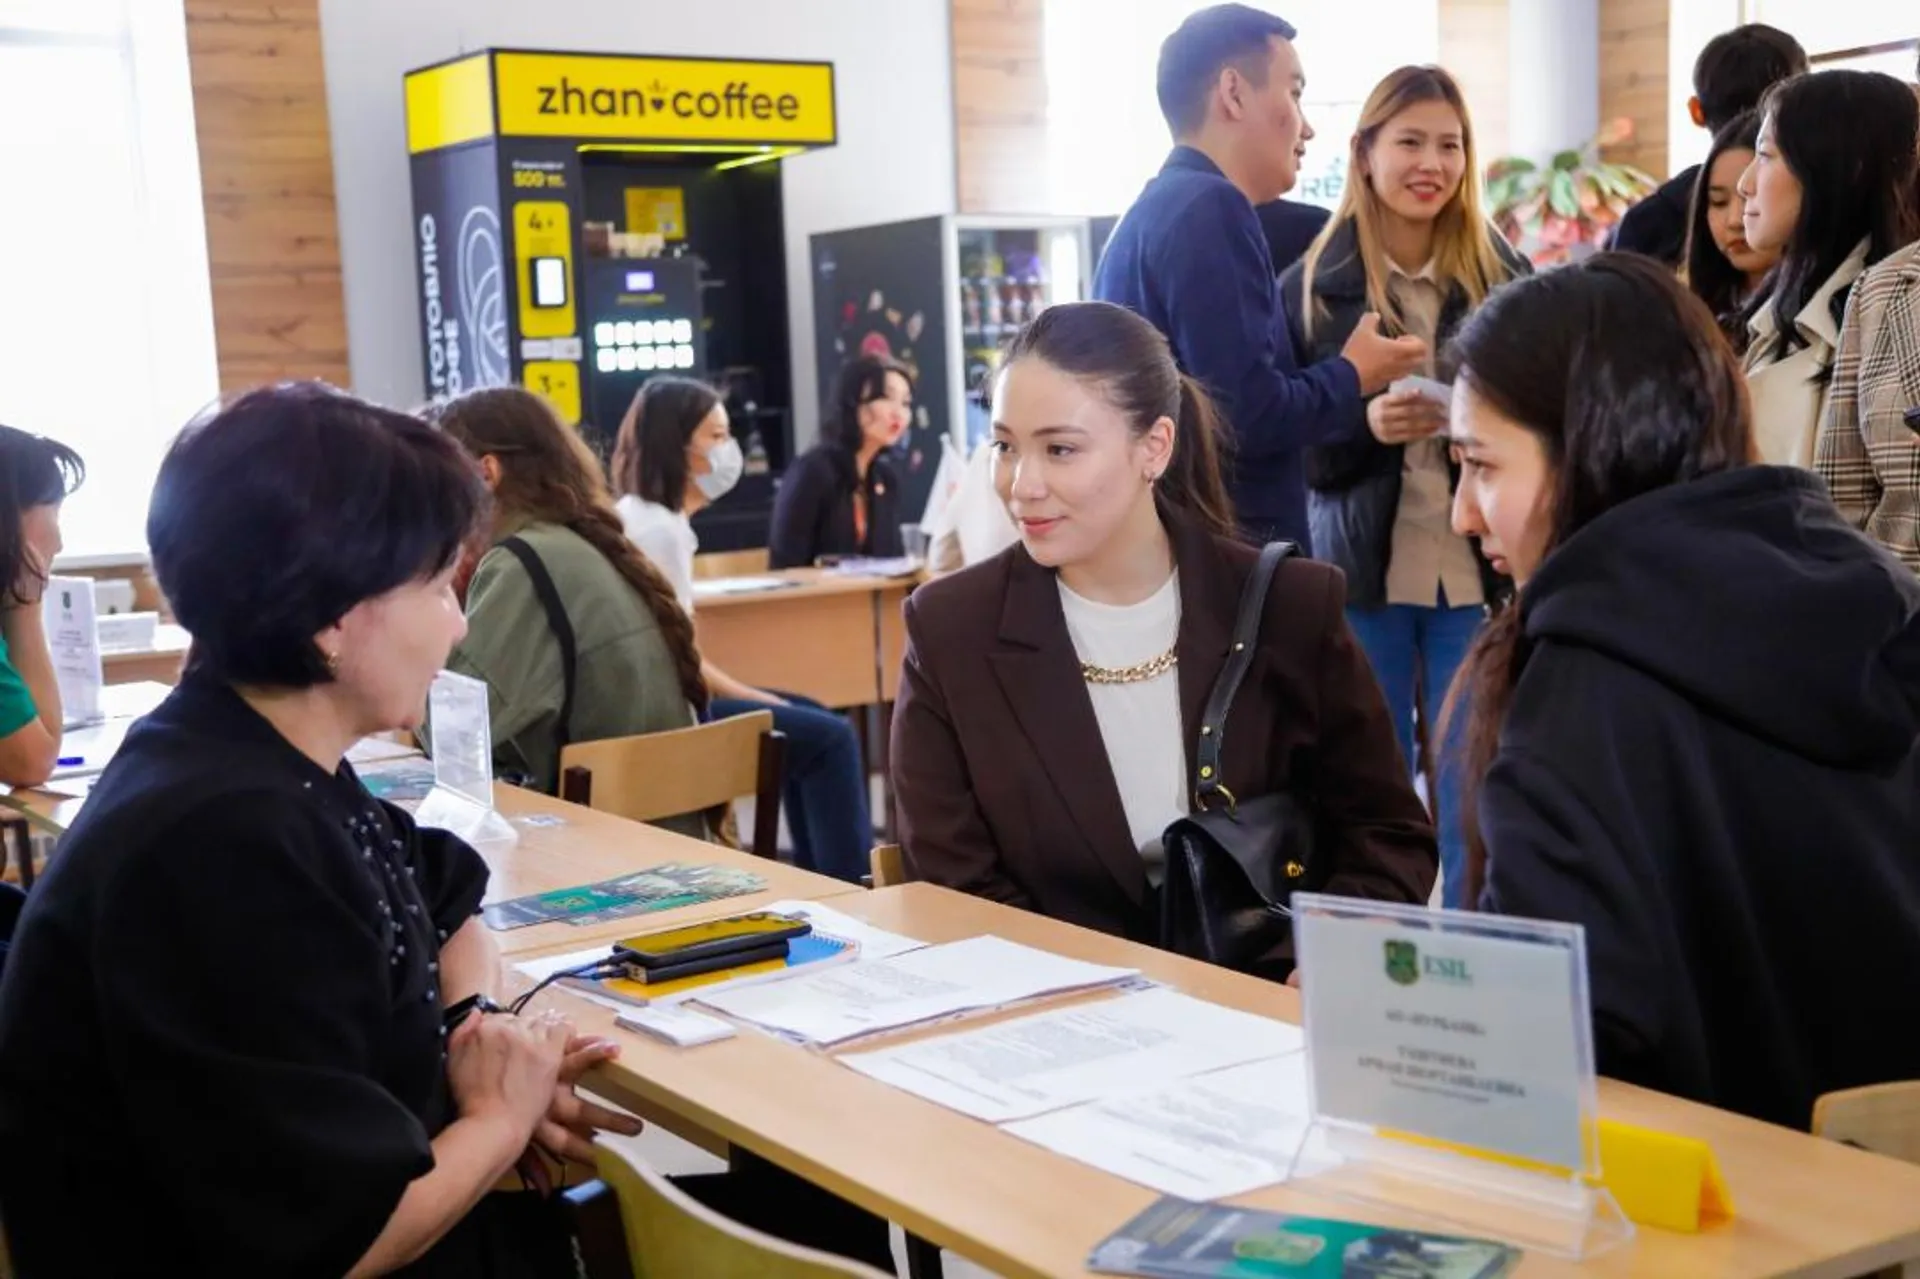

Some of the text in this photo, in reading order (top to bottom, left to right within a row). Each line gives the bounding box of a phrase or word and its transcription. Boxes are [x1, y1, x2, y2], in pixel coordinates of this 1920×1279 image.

[537, 76, 799, 121] zhan coffee
[444, 317, 462, 399] ОФЕ
